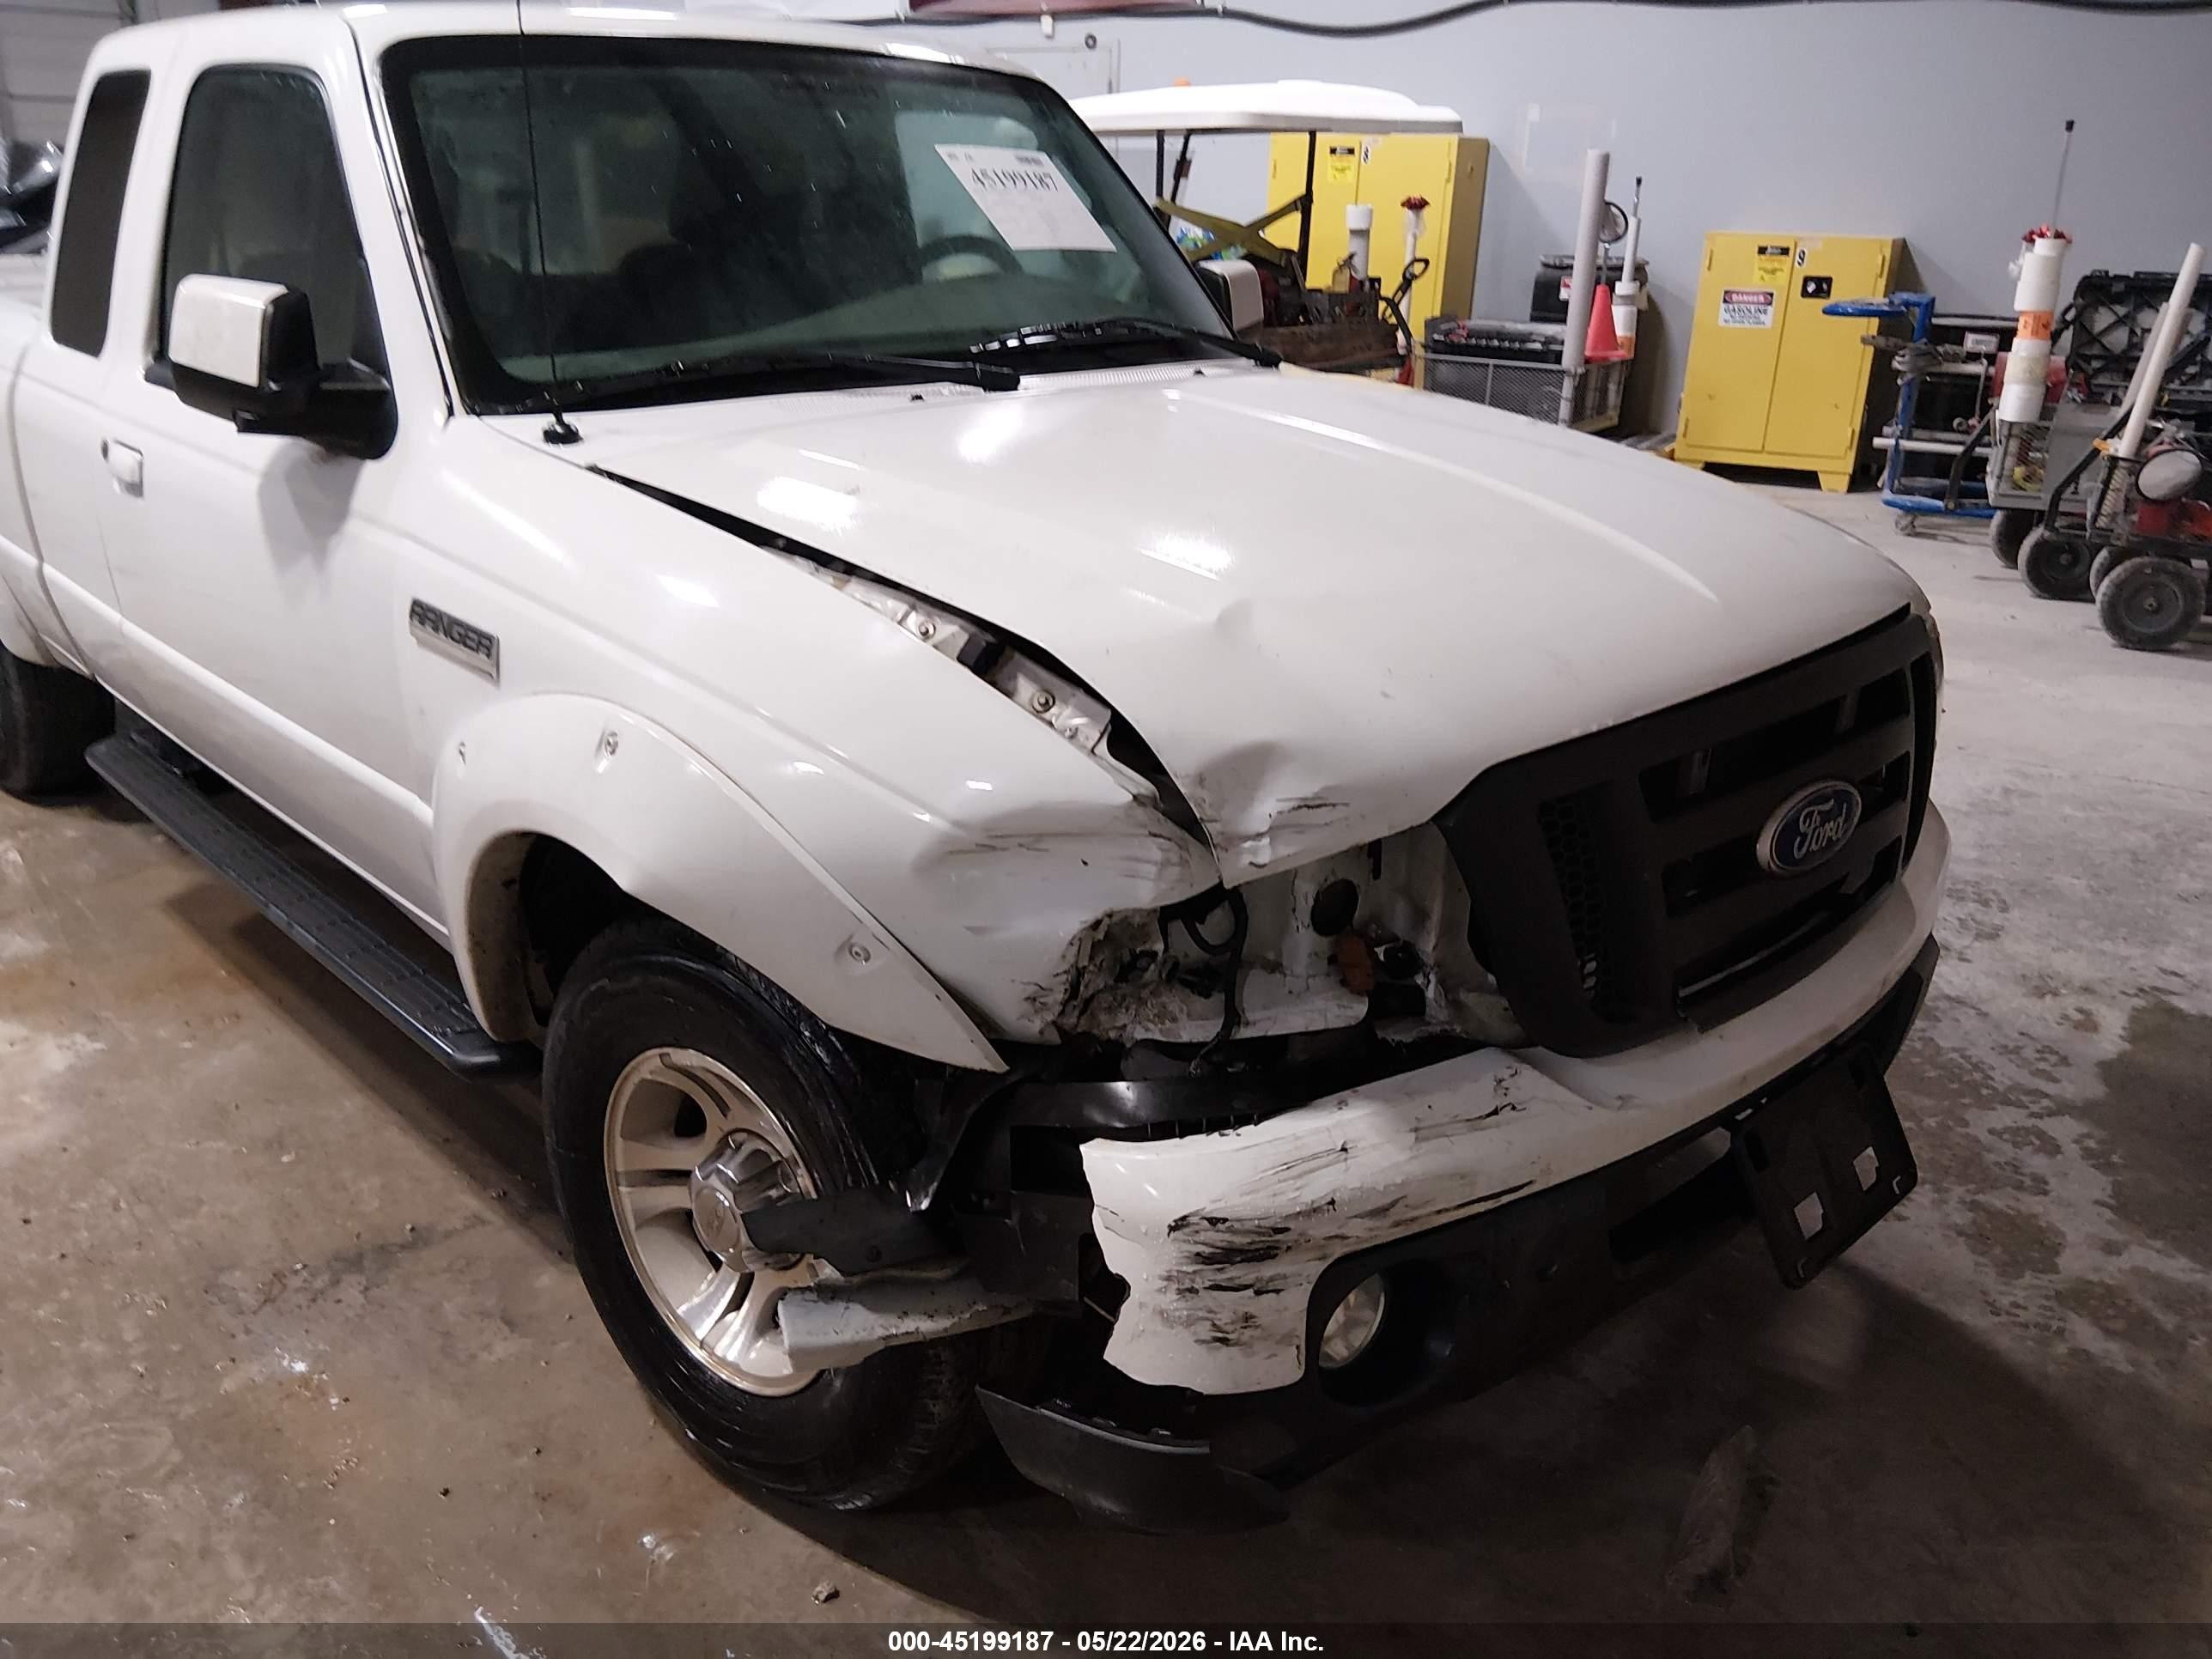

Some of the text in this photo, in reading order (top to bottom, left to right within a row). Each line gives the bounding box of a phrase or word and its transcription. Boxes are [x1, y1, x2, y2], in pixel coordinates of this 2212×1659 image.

[971, 169, 1058, 191] 45199187
[1731, 293, 1765, 303] DANGER
[410, 598, 492, 659] RANGER
[1794, 798, 1847, 860] Ford
